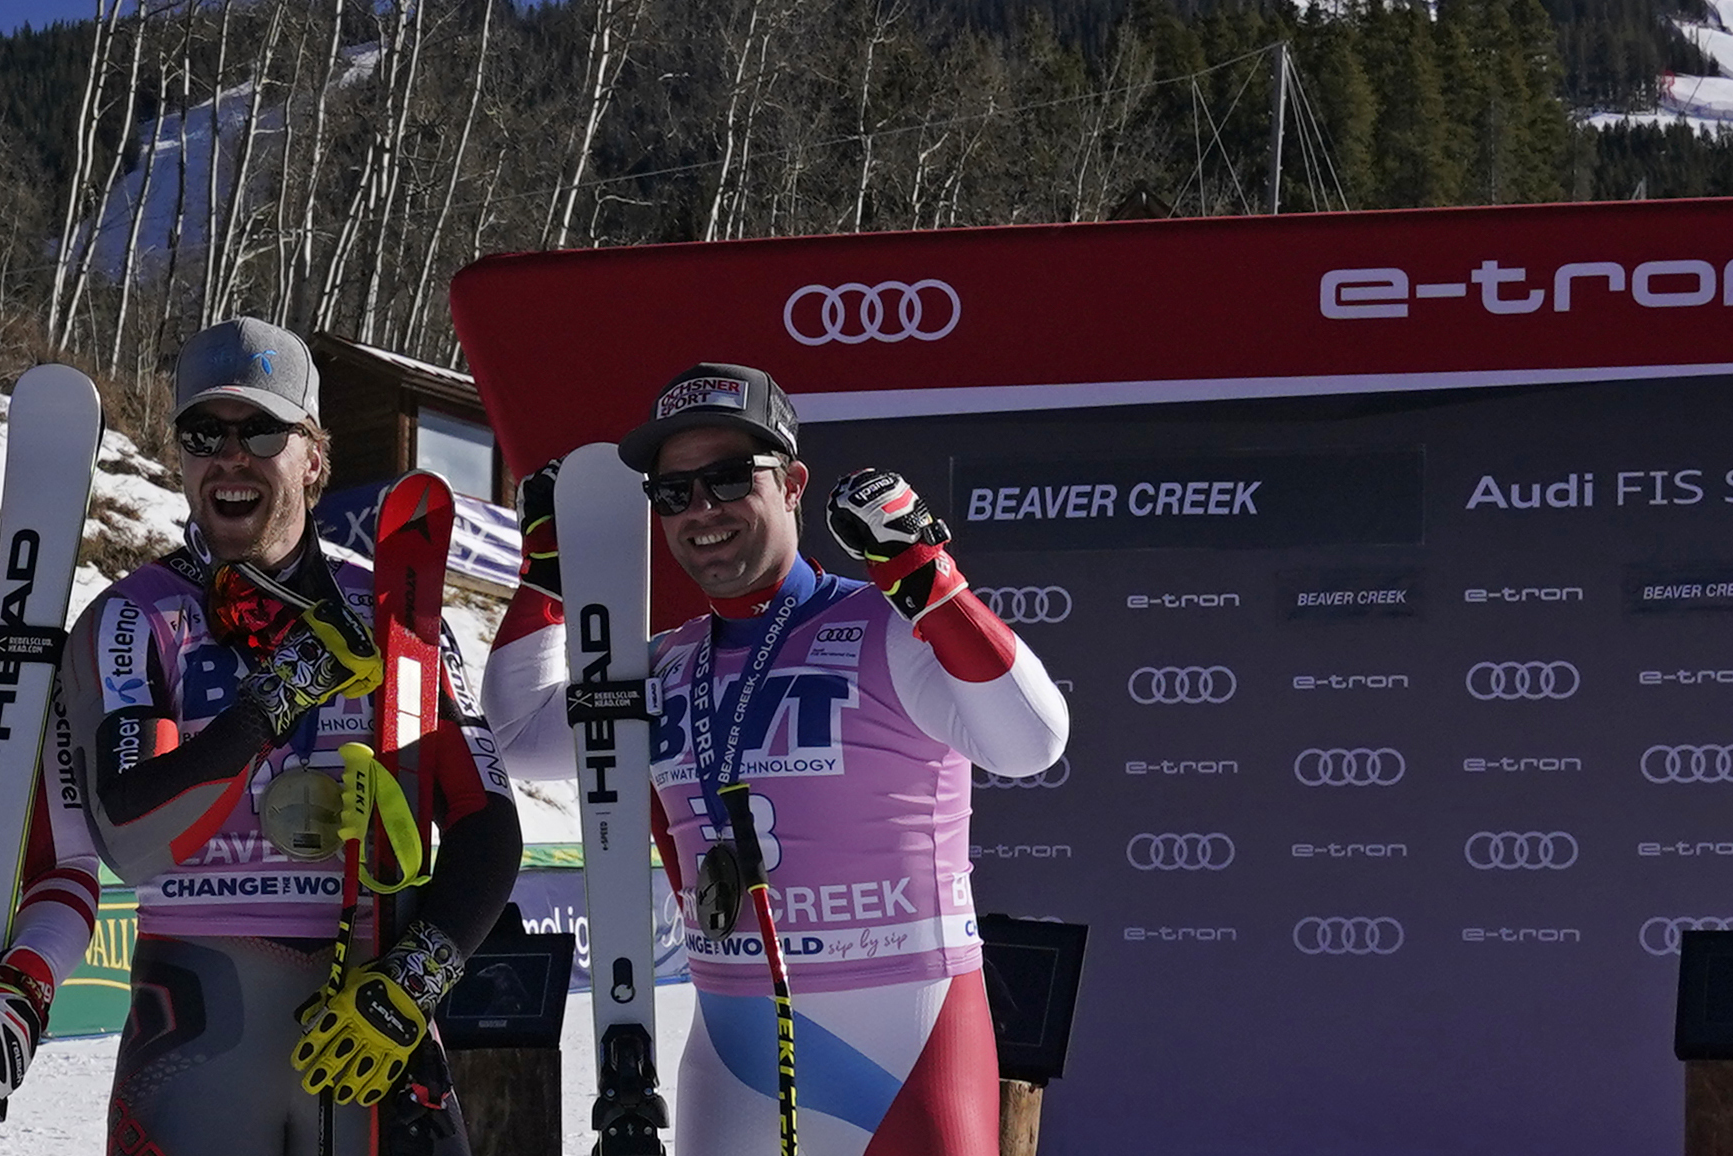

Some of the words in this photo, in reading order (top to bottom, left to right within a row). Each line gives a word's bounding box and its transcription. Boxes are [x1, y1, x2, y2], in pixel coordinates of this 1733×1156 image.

[1319, 260, 1733, 320] e-tro
[661, 379, 740, 407] OCHSNER
[661, 392, 711, 416] SPORT
[967, 482, 1117, 522] BEAVER
[1127, 480, 1263, 516] CREEK
[1465, 473, 1594, 510] Audi
[1617, 470, 1703, 506] FIS
[1127, 594, 1240, 609] e-tron
[1297, 591, 1354, 606] BEAVER
[1357, 589, 1407, 604] CREEK
[1464, 587, 1583, 602] e-tron
[1642, 583, 1703, 600] BEAVER
[109, 600, 140, 677] telenor
[1293, 674, 1409, 689] e-tron
[1639, 669, 1733, 685] e-tro
[694, 682, 709, 710] OF
[718, 725, 741, 783] BEAVER
[734, 673, 761, 723] CREEK,
[753, 596, 797, 671] COLORADO
[579, 603, 619, 804] HEAD
[476, 738, 508, 789] DNB
[1125, 760, 1238, 775] e-tron
[1463, 757, 1581, 772] e-tron
[355, 770, 366, 815] LEKI
[1292, 843, 1407, 858] e-tron
[1637, 840, 1733, 857] e-tro
[162, 877, 279, 898] CHANGE
[282, 876, 291, 895] THE
[768, 876, 917, 923] CREEK
[828, 940, 854, 958] sip
[859, 929, 879, 956] by
[883, 932, 908, 950] sip
[1124, 927, 1236, 941] e-tron
[1462, 928, 1580, 942] e-tron
[774, 996, 795, 1078] LEKI
